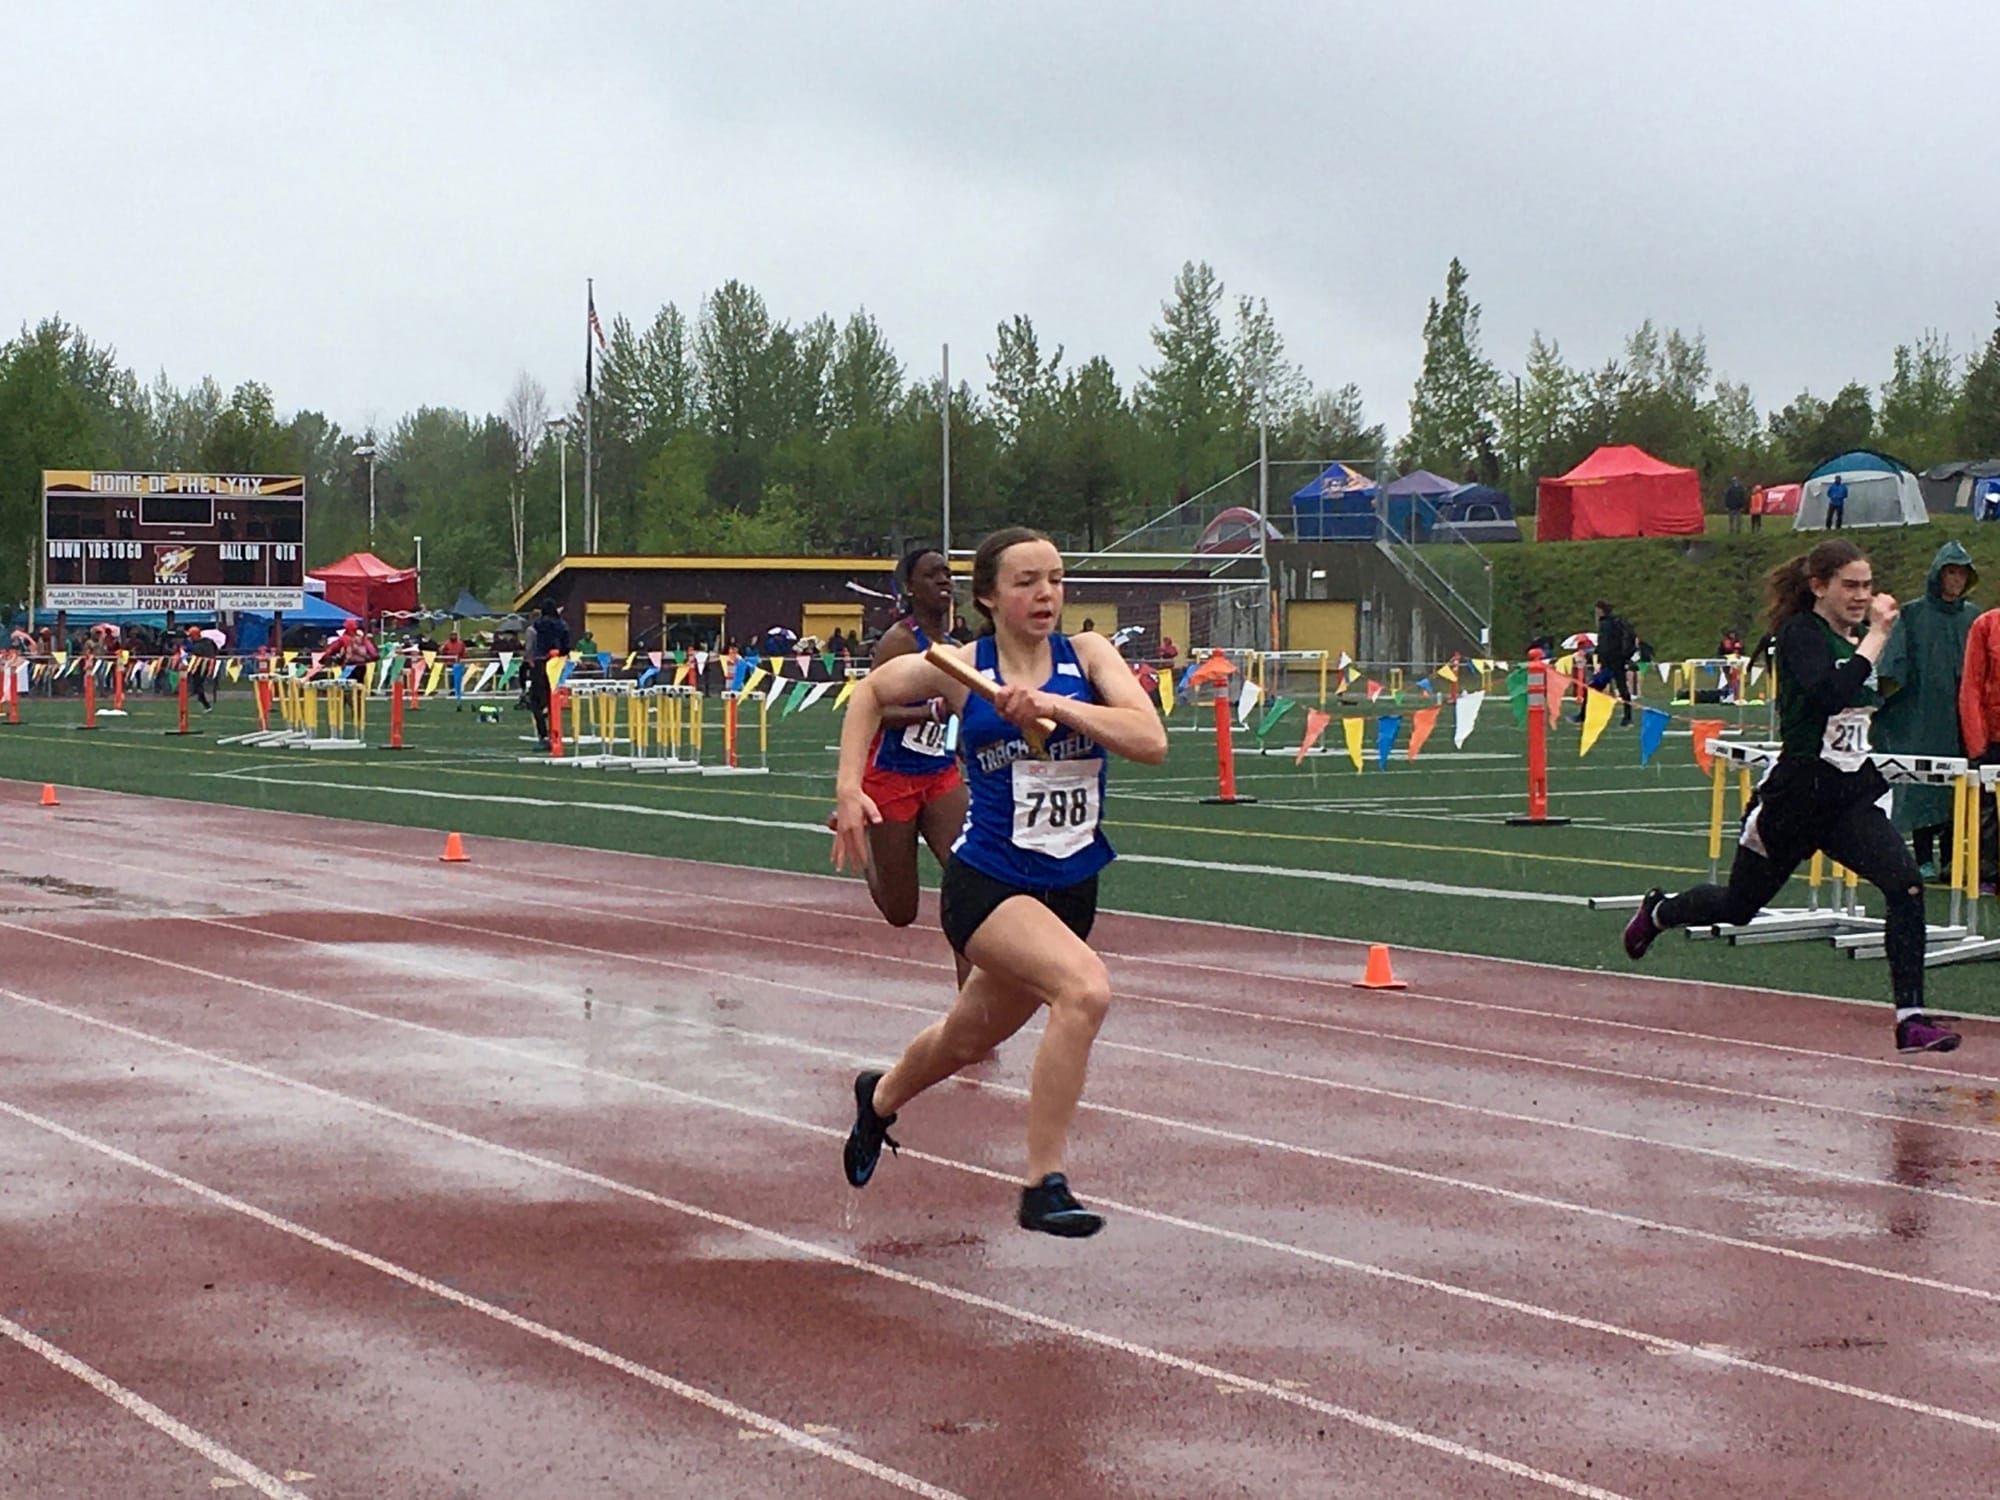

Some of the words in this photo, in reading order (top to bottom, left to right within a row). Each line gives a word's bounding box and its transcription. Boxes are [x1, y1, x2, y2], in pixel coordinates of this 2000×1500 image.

[90, 474, 143, 492] HOME
[148, 475, 170, 493] OF
[176, 476, 210, 494] THE
[215, 477, 263, 495] LYNX
[49, 542, 81, 558] DOWN
[88, 542, 110, 559] YDS
[112, 543, 126, 559] TO
[127, 543, 142, 559] GO
[219, 544, 243, 560] BALL
[245, 544, 260, 561] ON
[275, 545, 296, 561] QTR
[154, 575, 188, 584] LYNX
[178, 589, 215, 598] ALUMNI
[137, 599, 215, 610] FOUNDATION
[1830, 724, 1864, 752] 271
[976, 738, 1030, 773] TRACK
[1049, 734, 1094, 761] FIELD
[1026, 787, 1088, 828] 788
